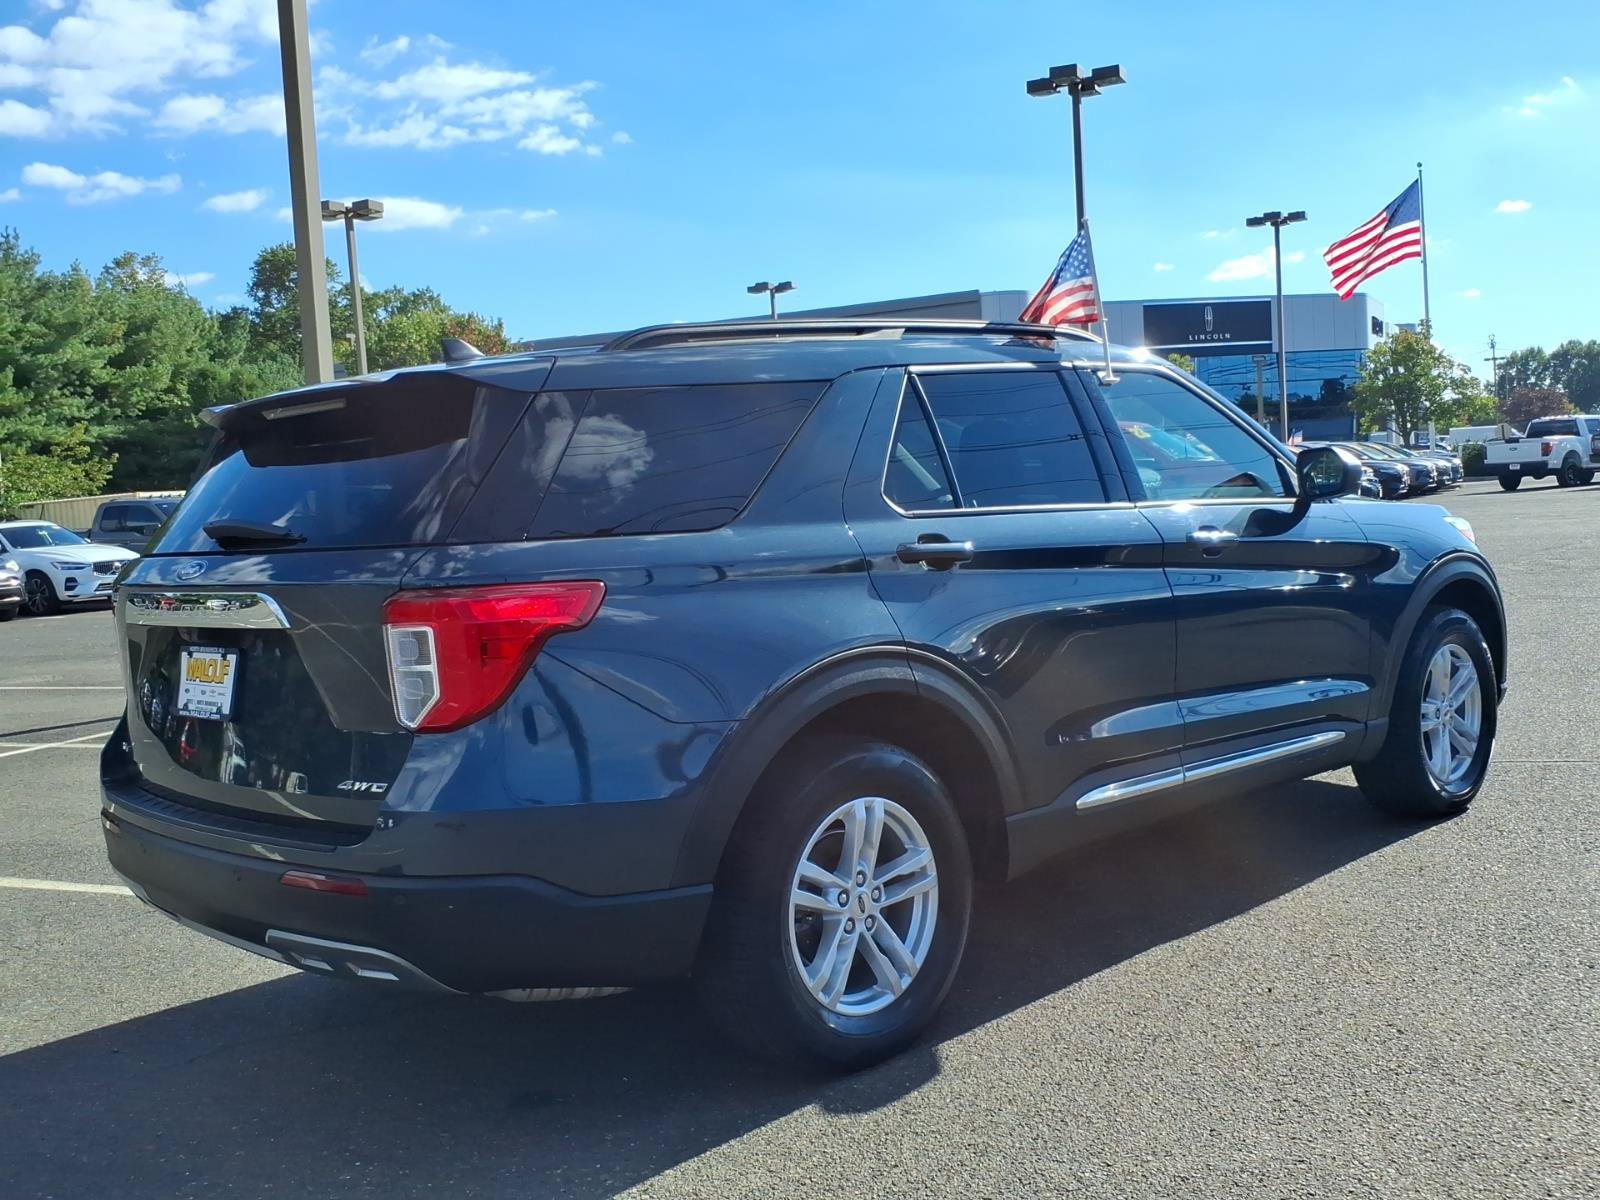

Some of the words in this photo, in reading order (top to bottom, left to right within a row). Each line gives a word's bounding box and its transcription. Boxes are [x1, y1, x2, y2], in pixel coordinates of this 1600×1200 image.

[1188, 333, 1231, 341] LINCOLN
[186, 657, 230, 684] MALOUF
[336, 780, 388, 793] 4WD
